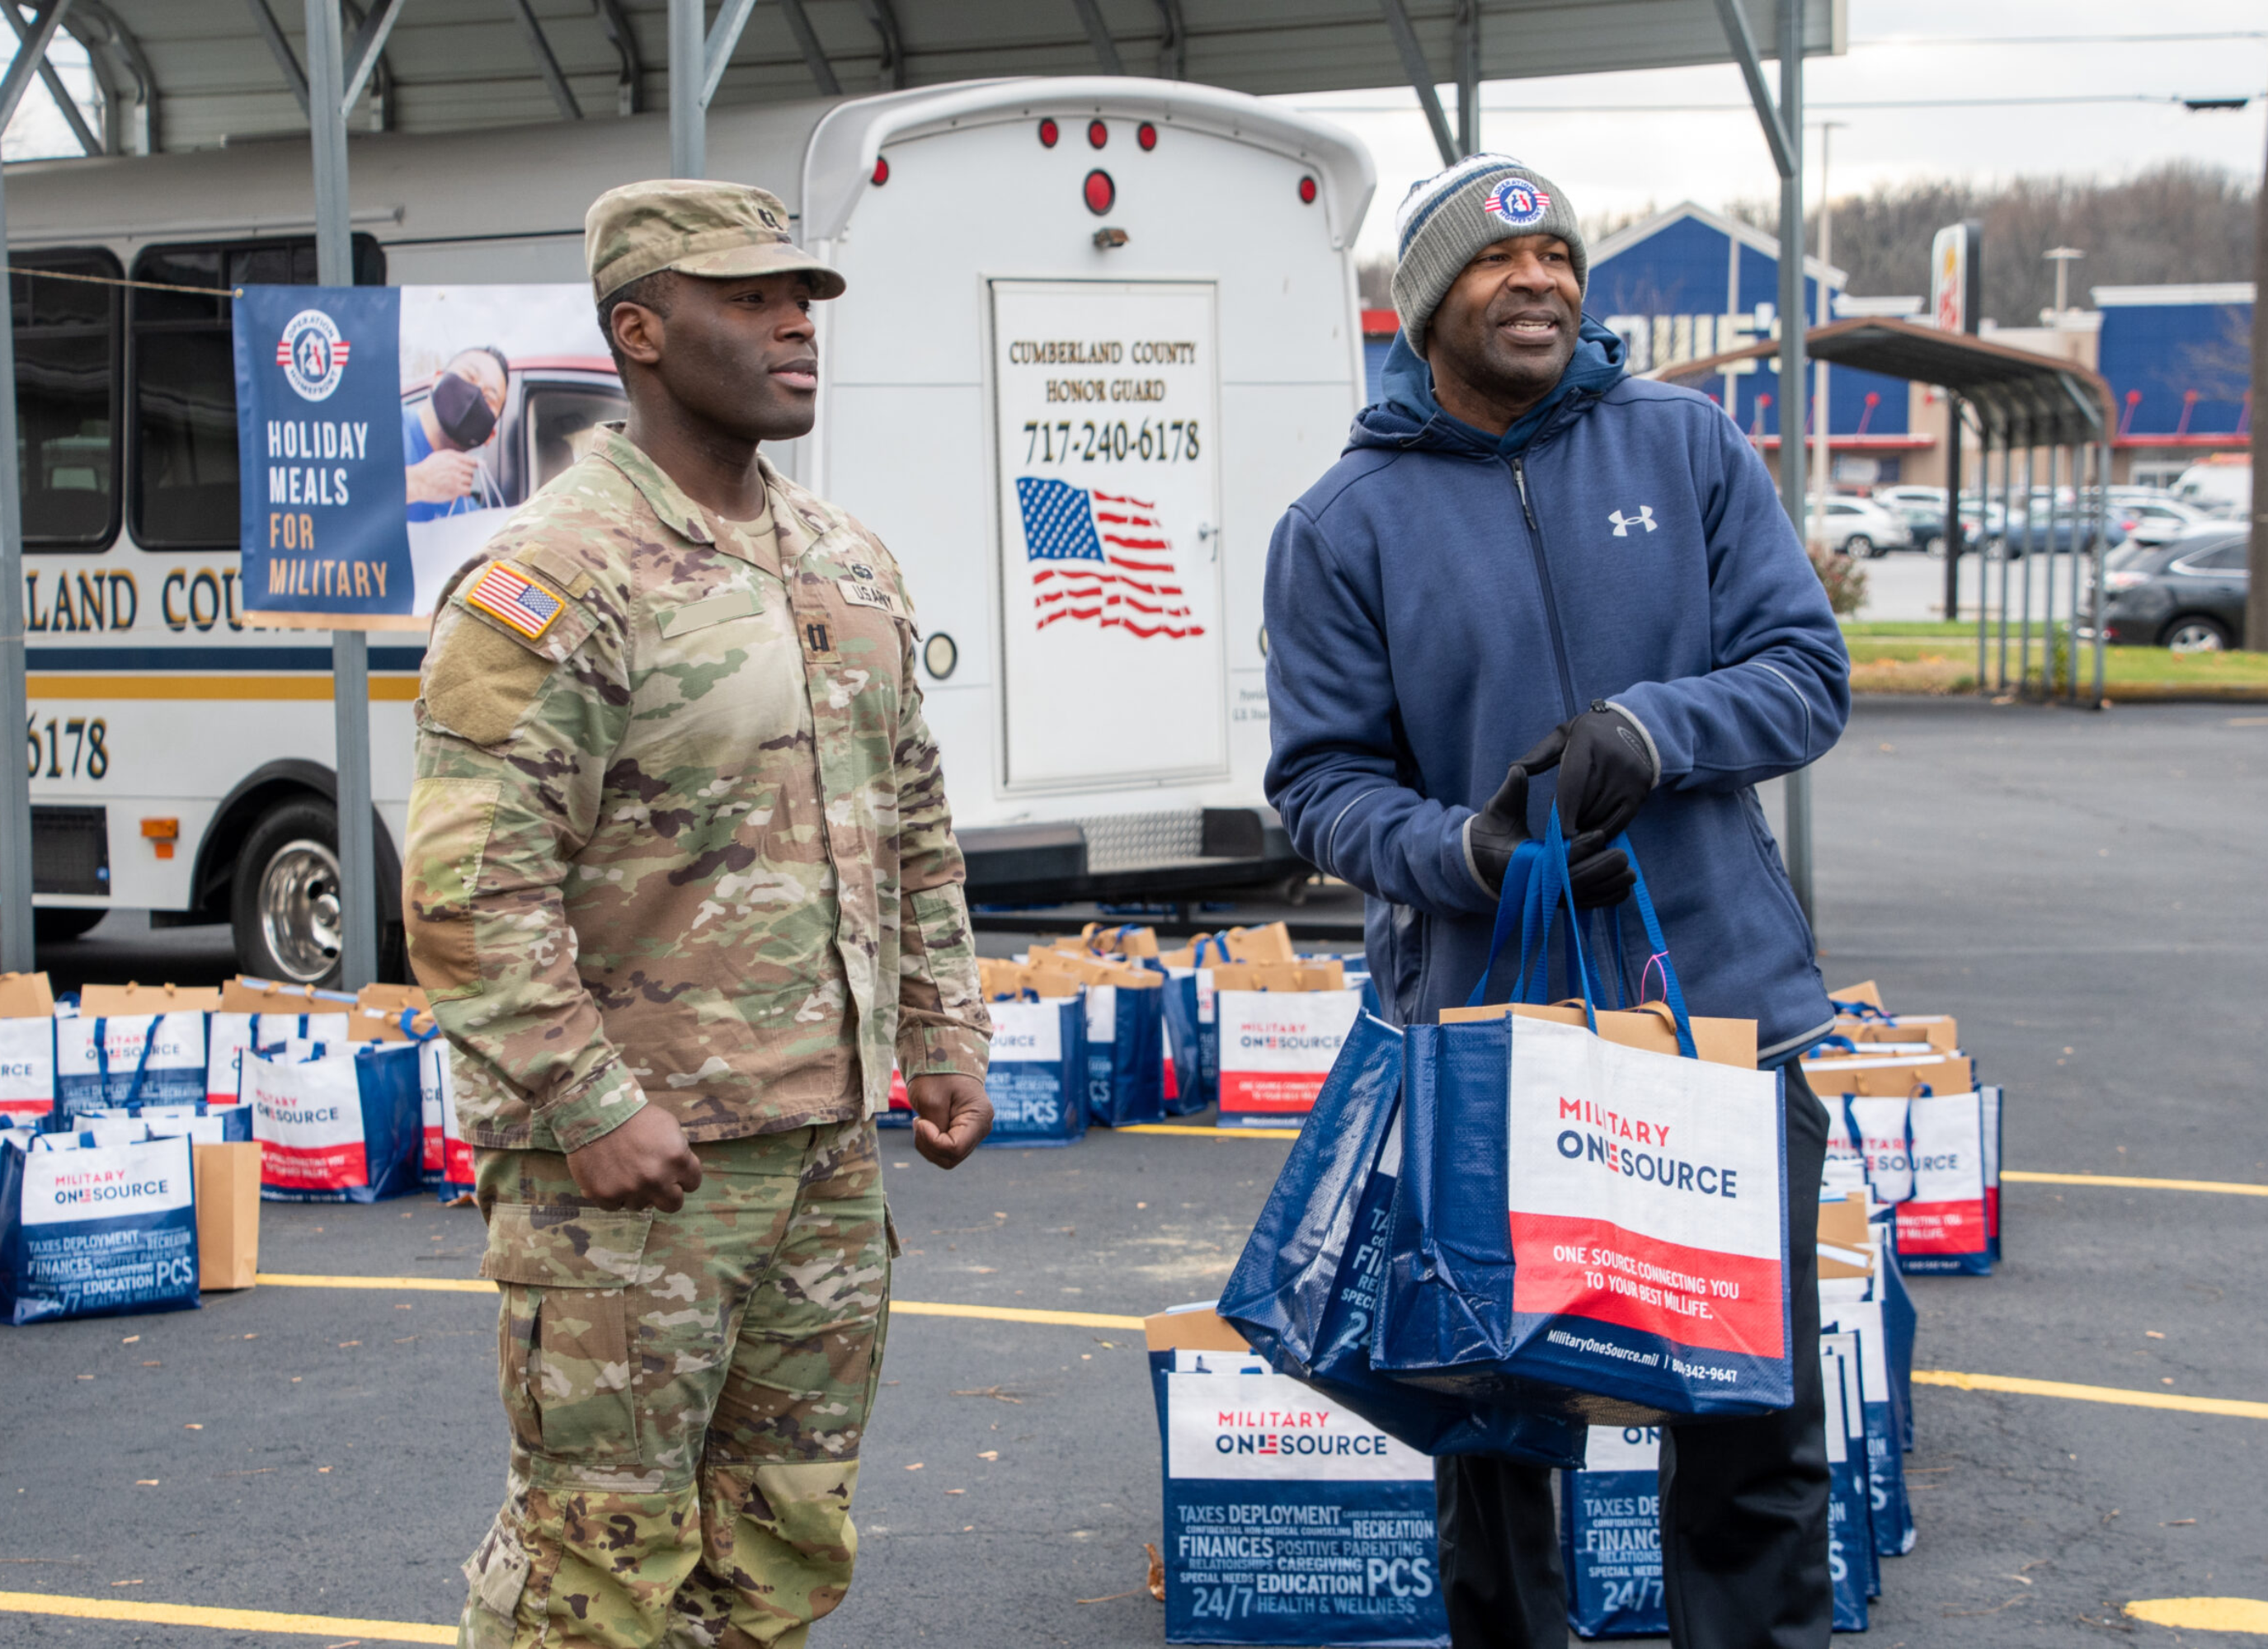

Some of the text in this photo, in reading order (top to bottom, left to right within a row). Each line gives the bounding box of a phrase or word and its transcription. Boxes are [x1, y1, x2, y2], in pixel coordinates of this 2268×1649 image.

[1604, 302, 1809, 374] OWE'
[1009, 341, 1196, 364] CUMBERLAND COUNTY
[1046, 379, 1165, 403] HONOR GUARD
[267, 420, 369, 460] HOLIDAY
[1023, 416, 1200, 465] 717-240-6178
[269, 466, 350, 506] MEALS
[270, 512, 314, 551] FOR
[269, 557, 388, 598] MILITARY
[24, 568, 138, 633] LAND
[27, 712, 111, 780] 6178
[1240, 1022, 1306, 1033] MILITARY
[1022, 1100, 1059, 1124] PCS
[1560, 1095, 1670, 1148] MILITARY
[55, 1169, 125, 1186] MILITARY
[27, 1239, 61, 1254] TAXES
[63, 1229, 140, 1251] DEPLOYMENT
[27, 1257, 92, 1276] FINANCES
[157, 1257, 194, 1287] PCS
[1553, 1245, 1739, 1299] ONE SOURCE CONNECTING YOU
[82, 1274, 155, 1294] EDUCATION
[1358, 1273, 1380, 1294] RE
[1585, 1271, 1604, 1290] TO
[1608, 1275, 1639, 1299] YOUR
[1639, 1284, 1662, 1307] BEST
[1547, 1329, 1659, 1367] MilitaryOneSource.mil
[1218, 1411, 1329, 1428] MILITARY
[1177, 1505, 1226, 1524] TAXES
[1228, 1504, 1342, 1525] DEPLOYMENT
[1583, 1498, 1635, 1517] TAXES
[1185, 1520, 1434, 1539] CONFIDENTIAL NON-MEDICAL COUNSELING RECREATION
[1593, 1518, 1653, 1528] CONFIDENTIAL
[1179, 1535, 1424, 1558] FINANCES POSITIVE PARENTING
[1597, 1550, 1662, 1564] RELATIONS
[1179, 1571, 1364, 1595] SPECIAL NEEDS EDUCATION
[1188, 1556, 1433, 1598] RELATIONSHIPS CAREGIVING PCS
[1588, 1566, 1630, 1578] SPECIAL
[1192, 1584, 1416, 1621] 24/7 HEALTH & WELLNESS
[1602, 1576, 1664, 1613] 24/7
